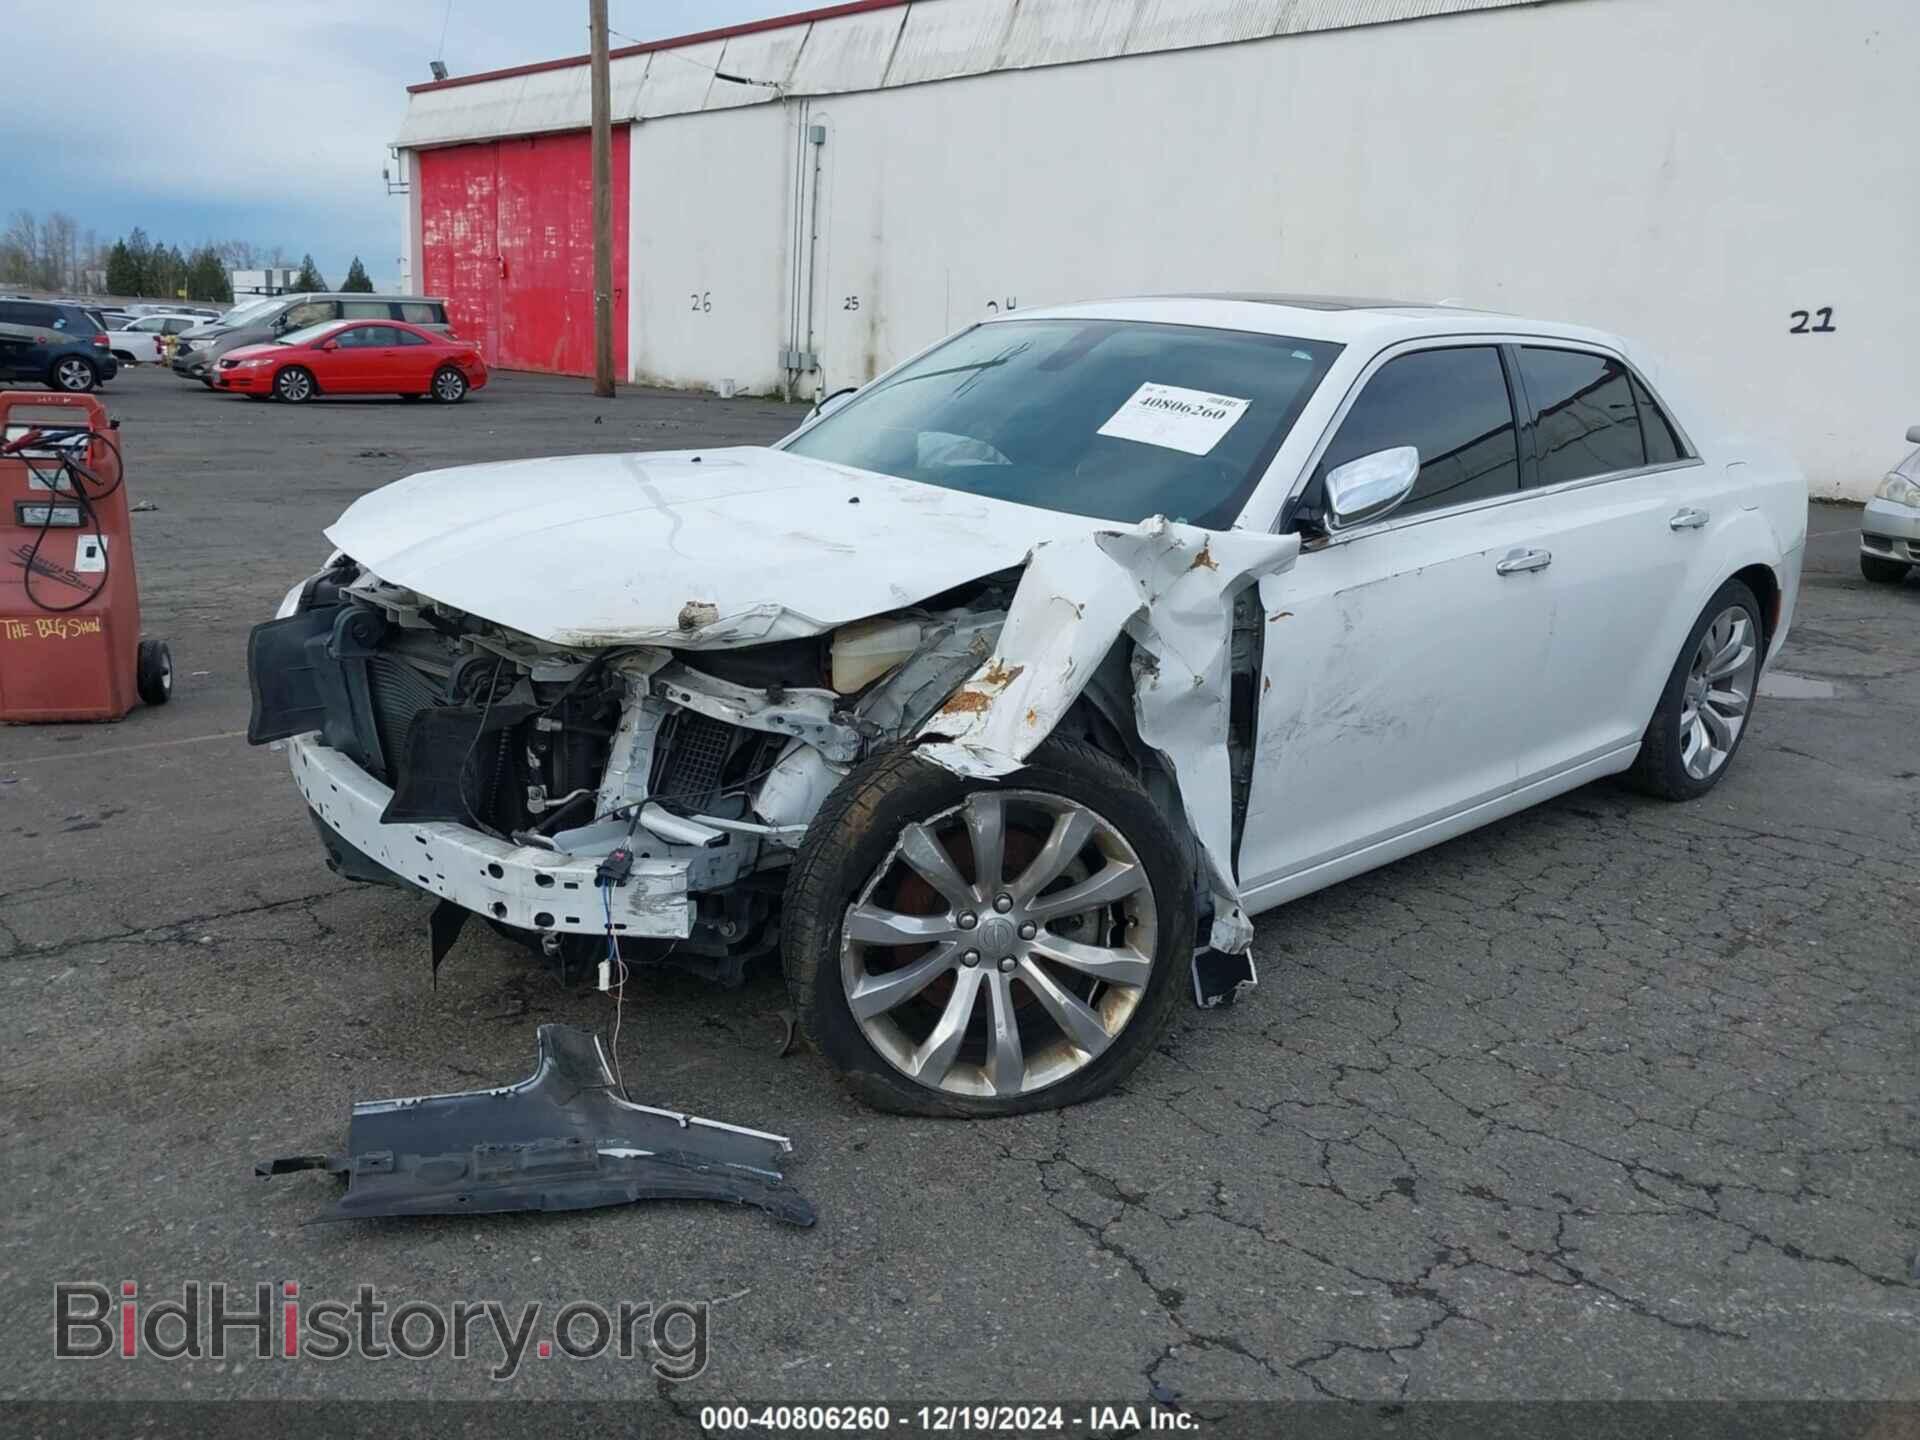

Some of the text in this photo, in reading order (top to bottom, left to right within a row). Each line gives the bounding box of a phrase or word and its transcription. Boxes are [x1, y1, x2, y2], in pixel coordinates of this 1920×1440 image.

[690, 291, 712, 313] 26
[843, 295, 860, 311] 25
[1788, 306, 1837, 334] 21
[1140, 397, 1228, 420] 40806260
[0, 618, 33, 640] THE
[35, 617, 68, 640] BIG
